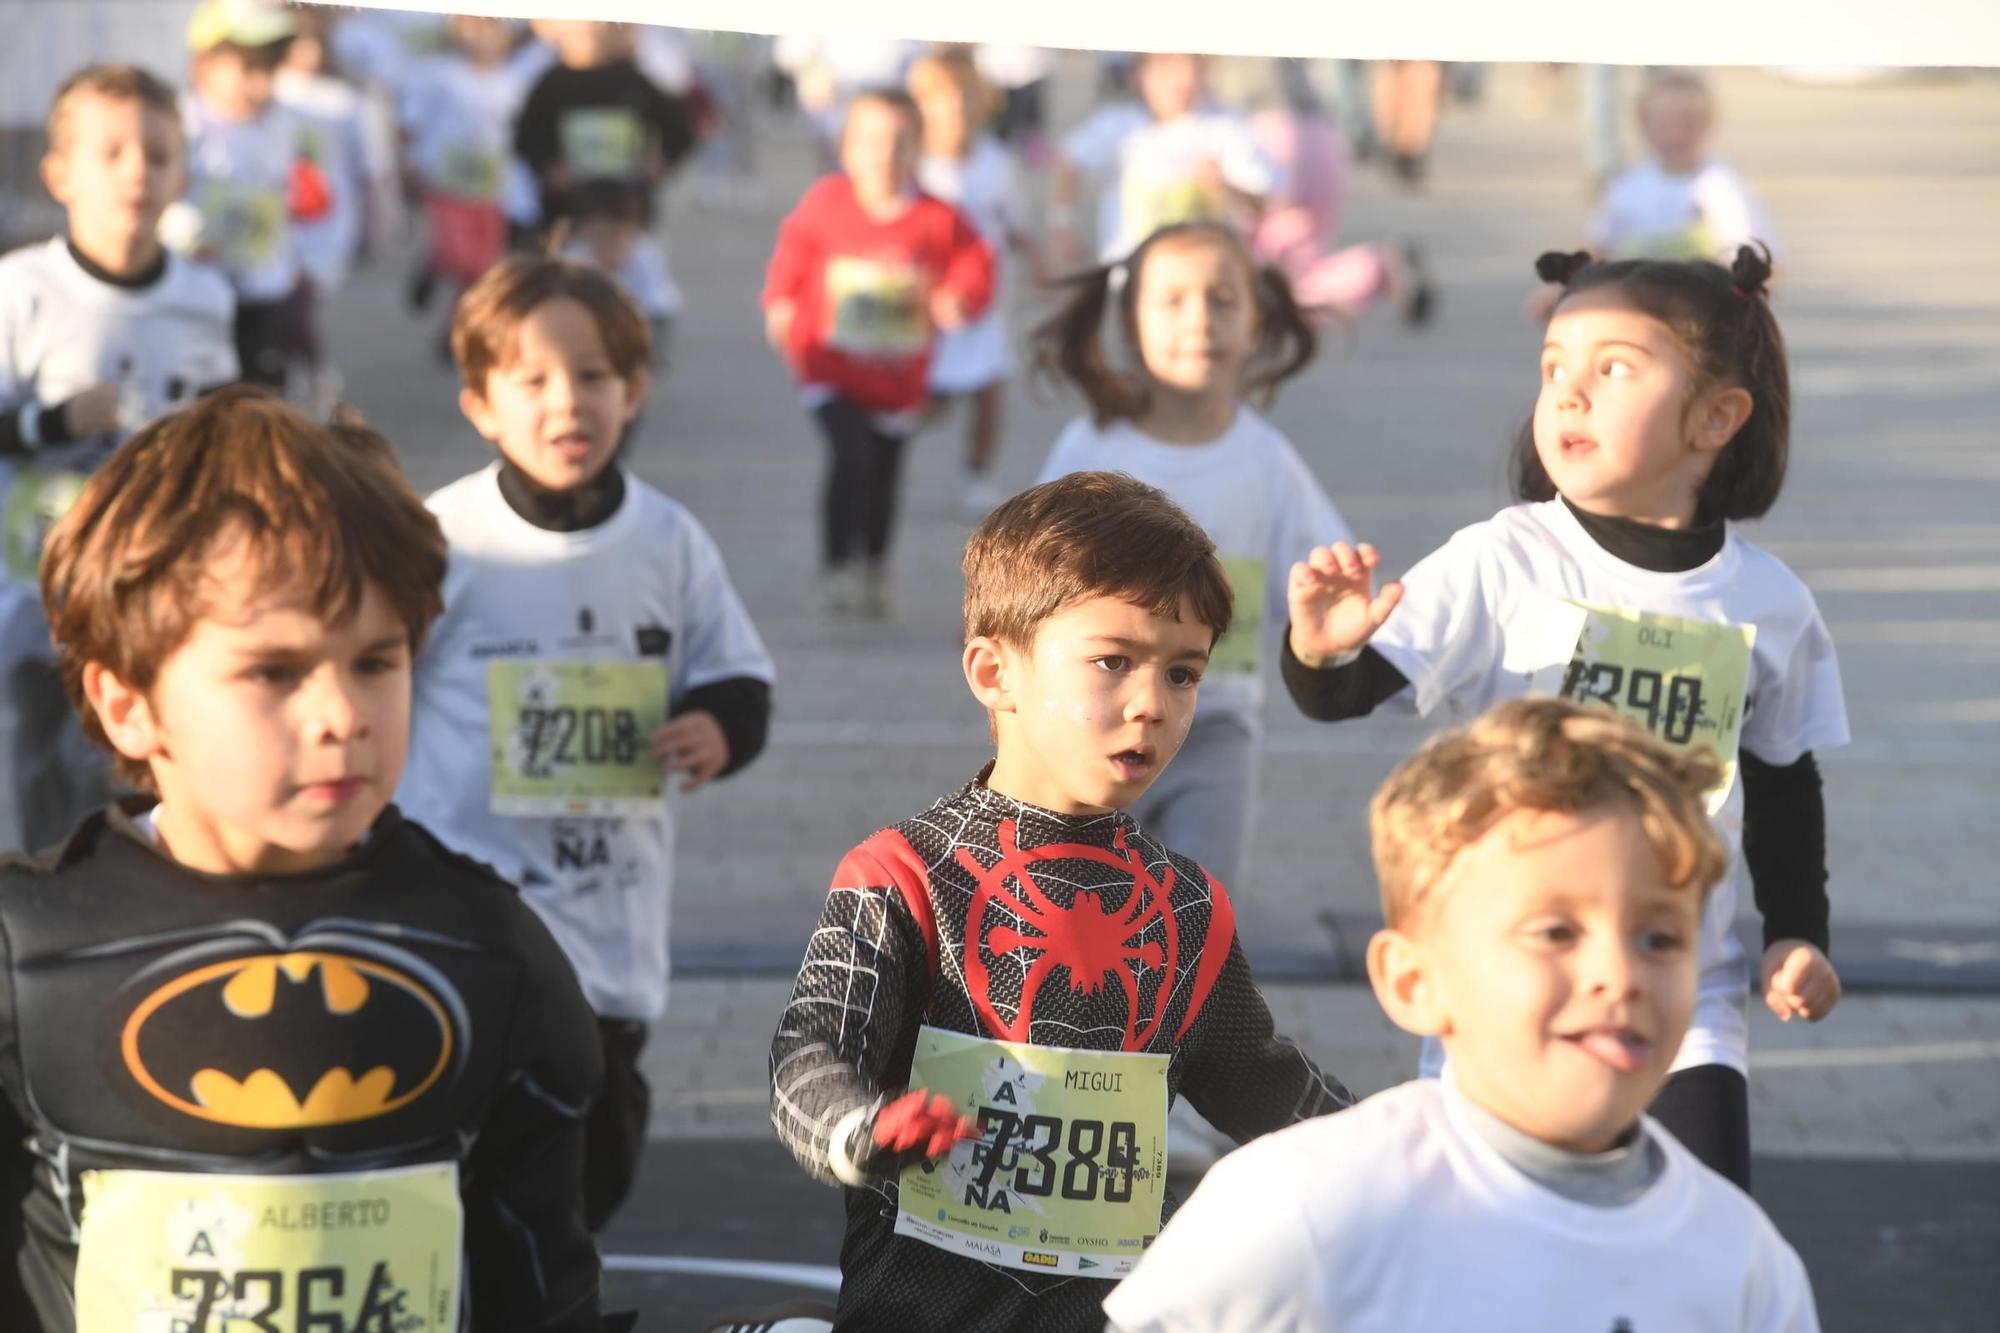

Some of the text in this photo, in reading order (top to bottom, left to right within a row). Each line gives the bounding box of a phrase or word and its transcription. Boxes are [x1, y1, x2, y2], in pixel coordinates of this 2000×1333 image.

[1638, 627, 1673, 647] OLI
[1064, 1069, 1123, 1092] MIGUI
[992, 1081, 1017, 1105] A
[976, 1106, 1136, 1203] 7389
[261, 1198, 390, 1230] ALBERTO
[187, 1231, 215, 1257] A
[965, 1240, 1001, 1257] MALASA
[1077, 1236, 1109, 1247] OYSHO
[1024, 1252, 1058, 1266] GADIS
